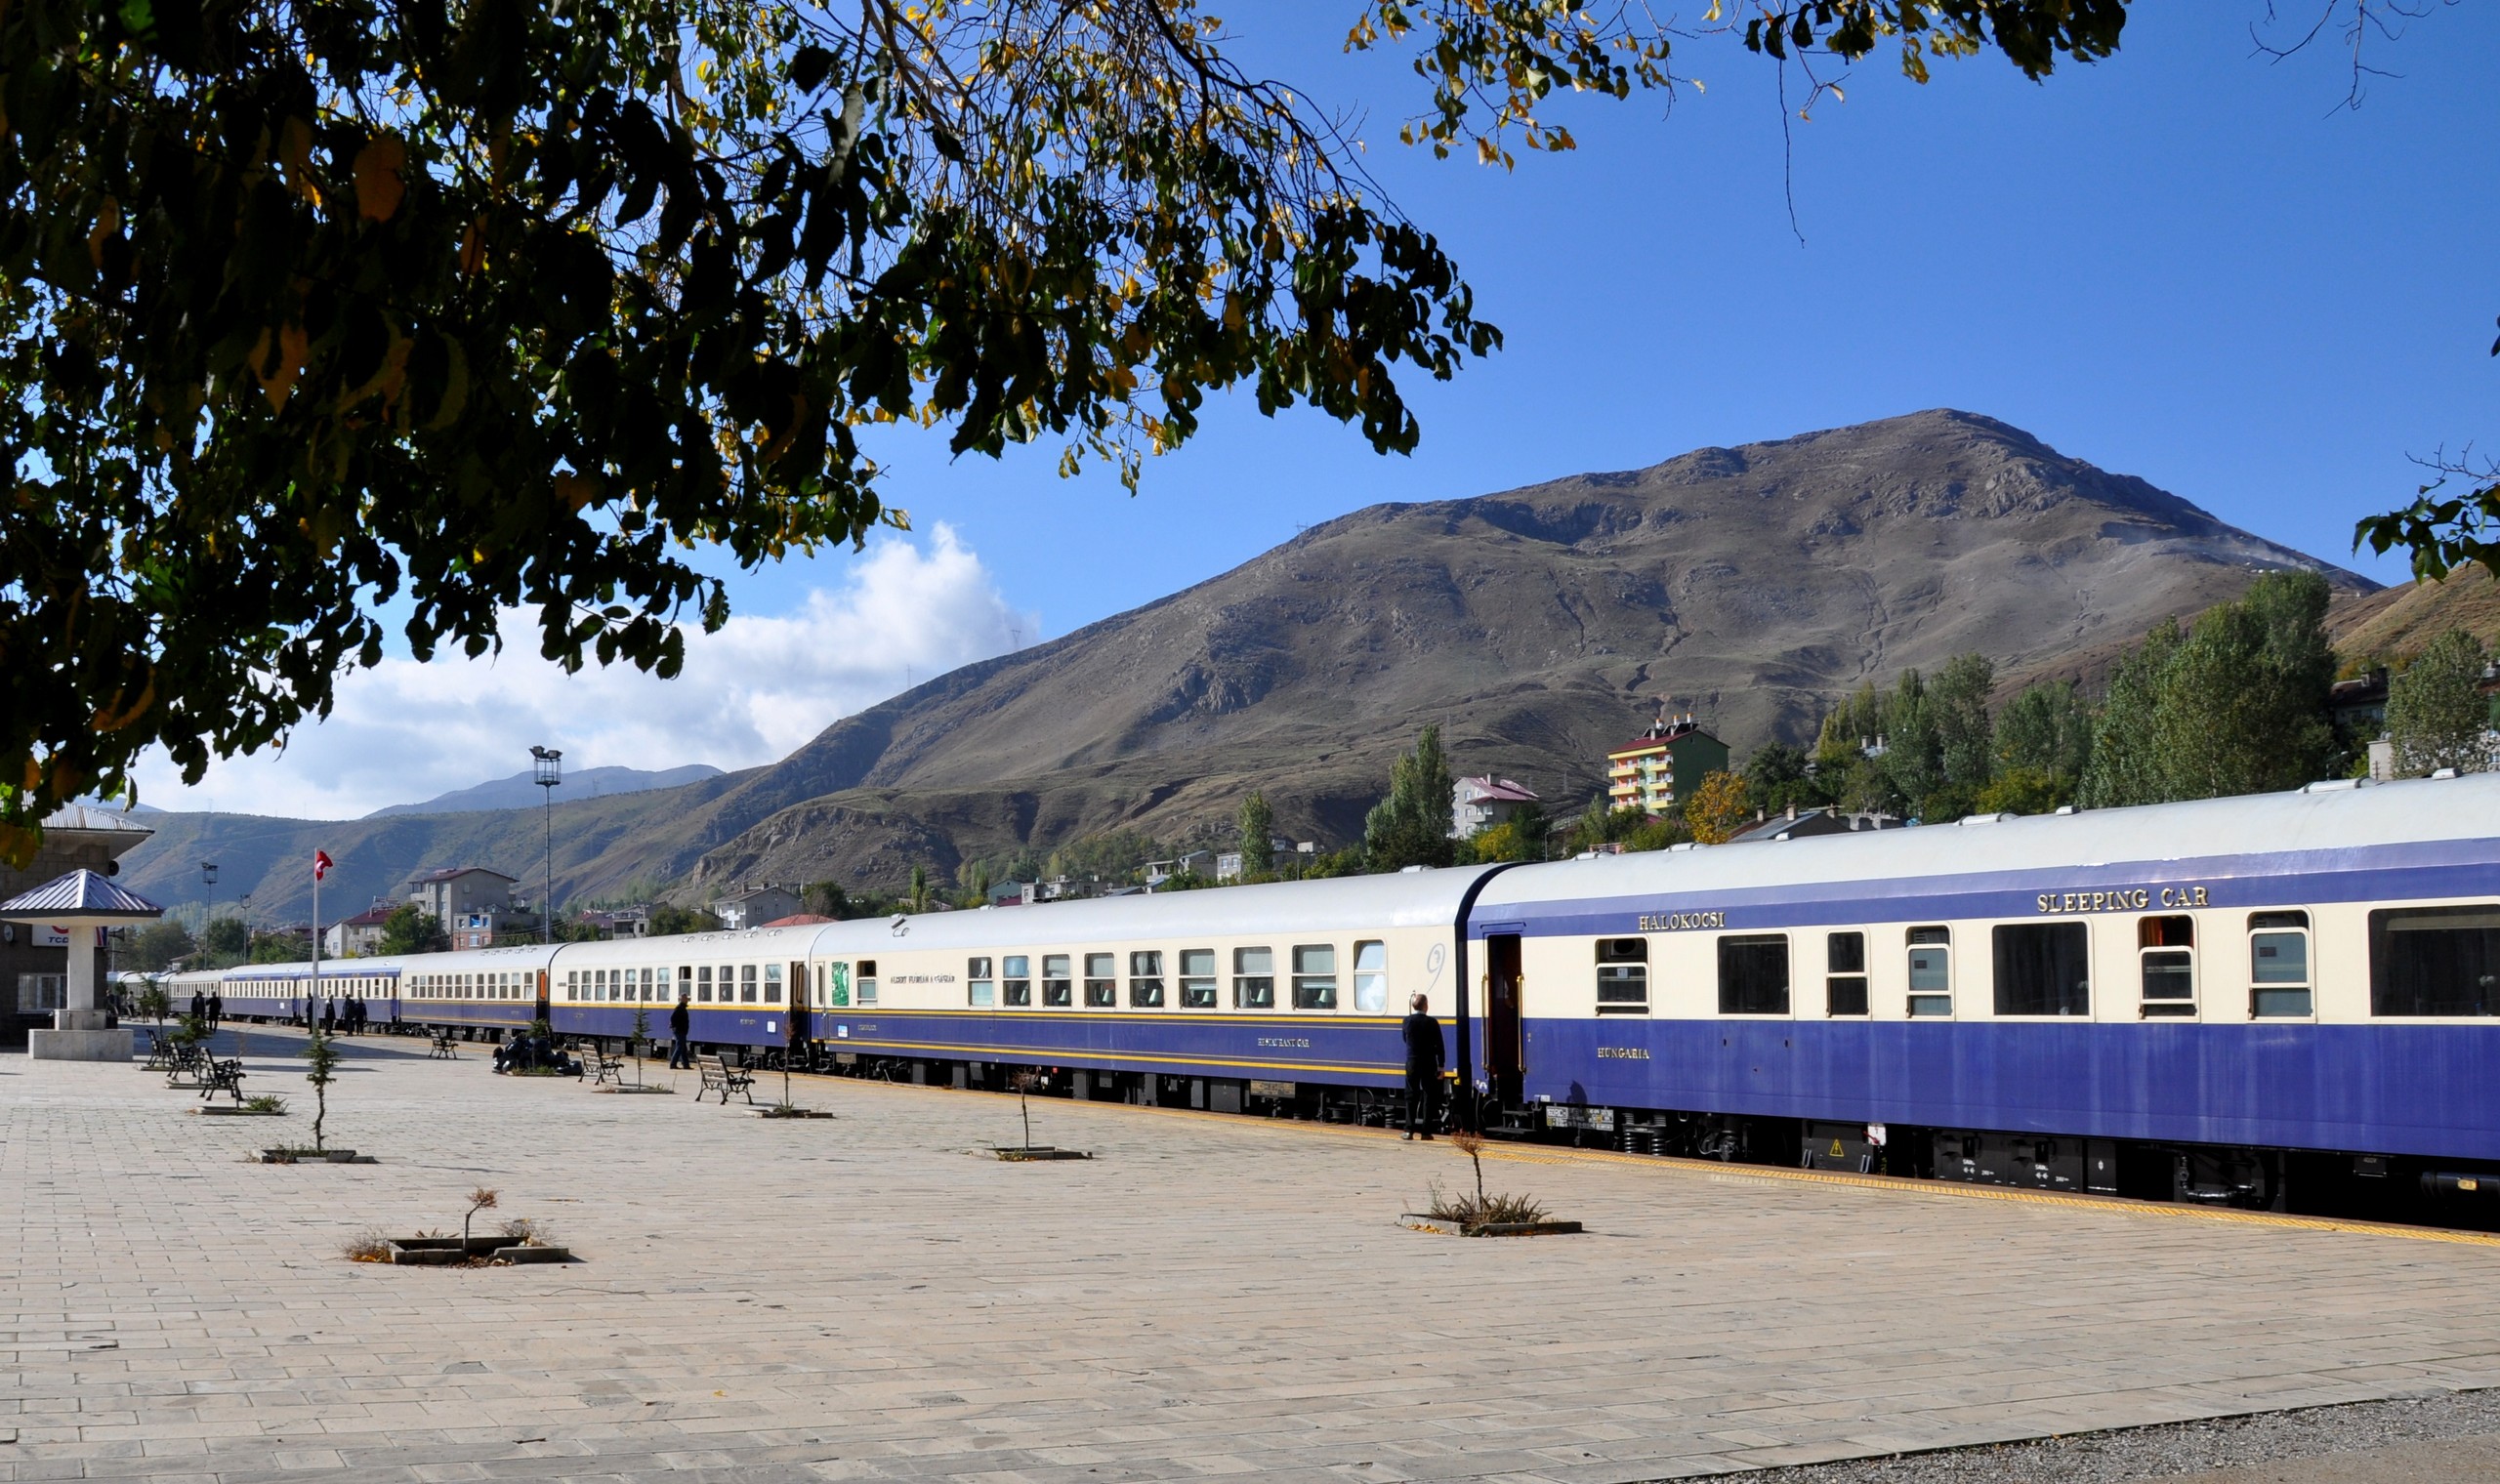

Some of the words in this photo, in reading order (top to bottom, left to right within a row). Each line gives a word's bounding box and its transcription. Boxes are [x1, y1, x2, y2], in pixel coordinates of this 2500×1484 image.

[2037, 888, 2149, 913] SLEEPING
[2160, 886, 2210, 907] CAR
[1639, 910, 1726, 931] HÁLÓKOCSI
[1597, 1047, 1650, 1060] HUNGARIA
